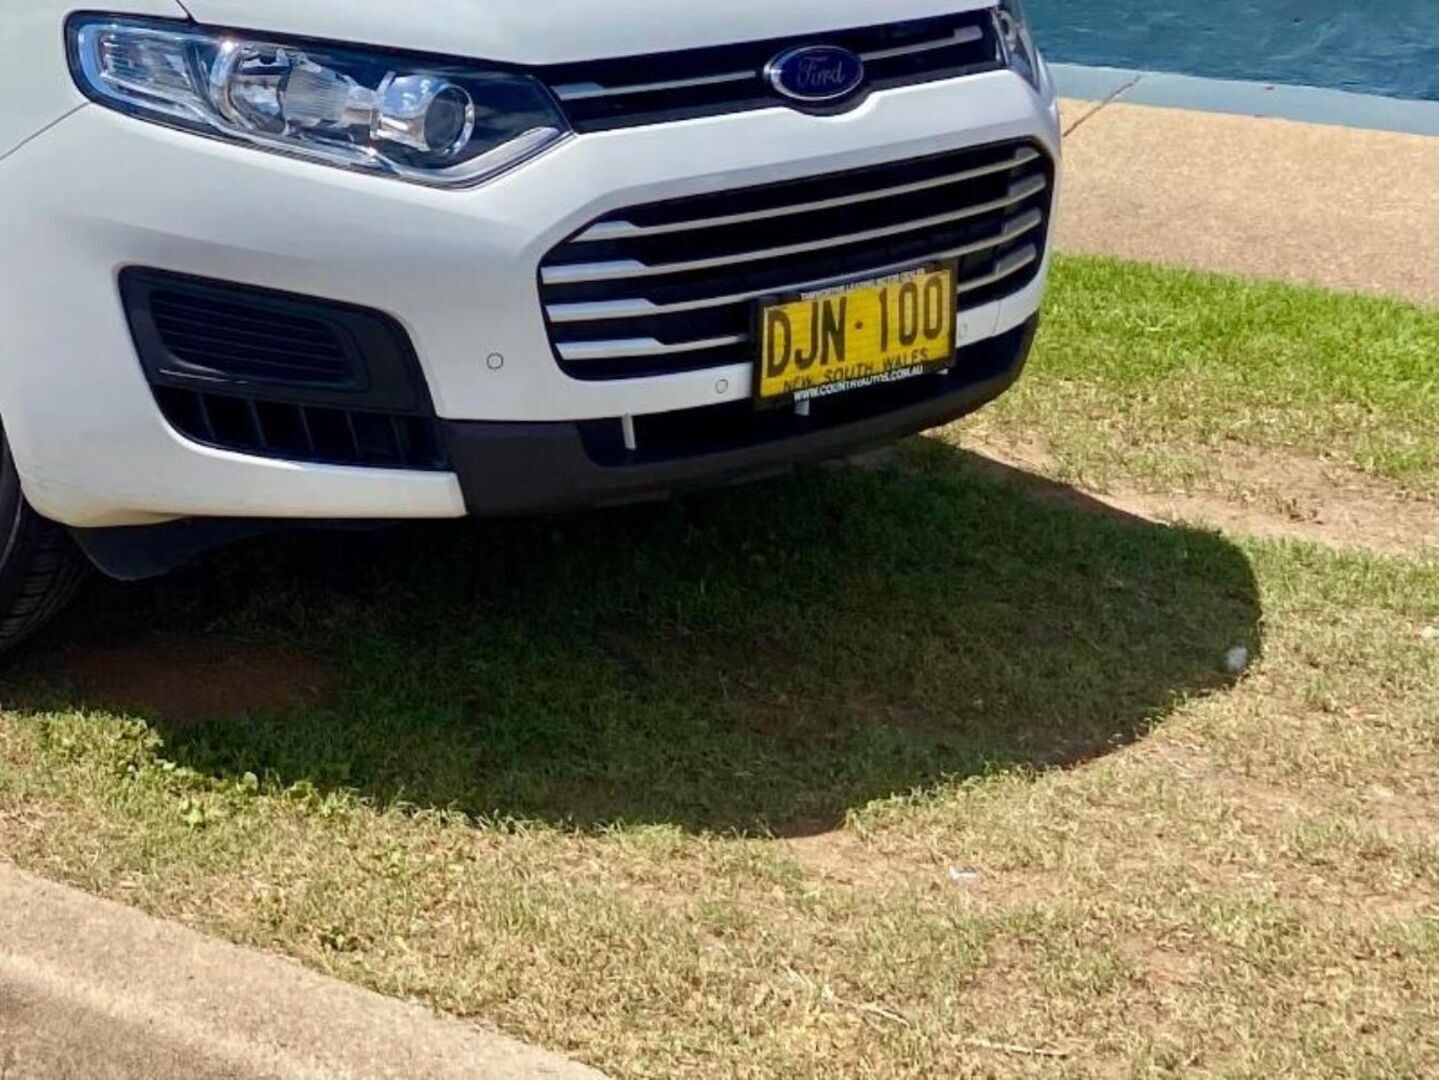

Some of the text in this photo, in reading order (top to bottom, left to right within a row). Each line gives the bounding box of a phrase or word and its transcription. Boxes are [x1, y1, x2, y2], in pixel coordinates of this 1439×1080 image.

[797, 55, 846, 90] Ford
[824, 362, 876, 383] SOUTH
[882, 347, 929, 371] WALES
